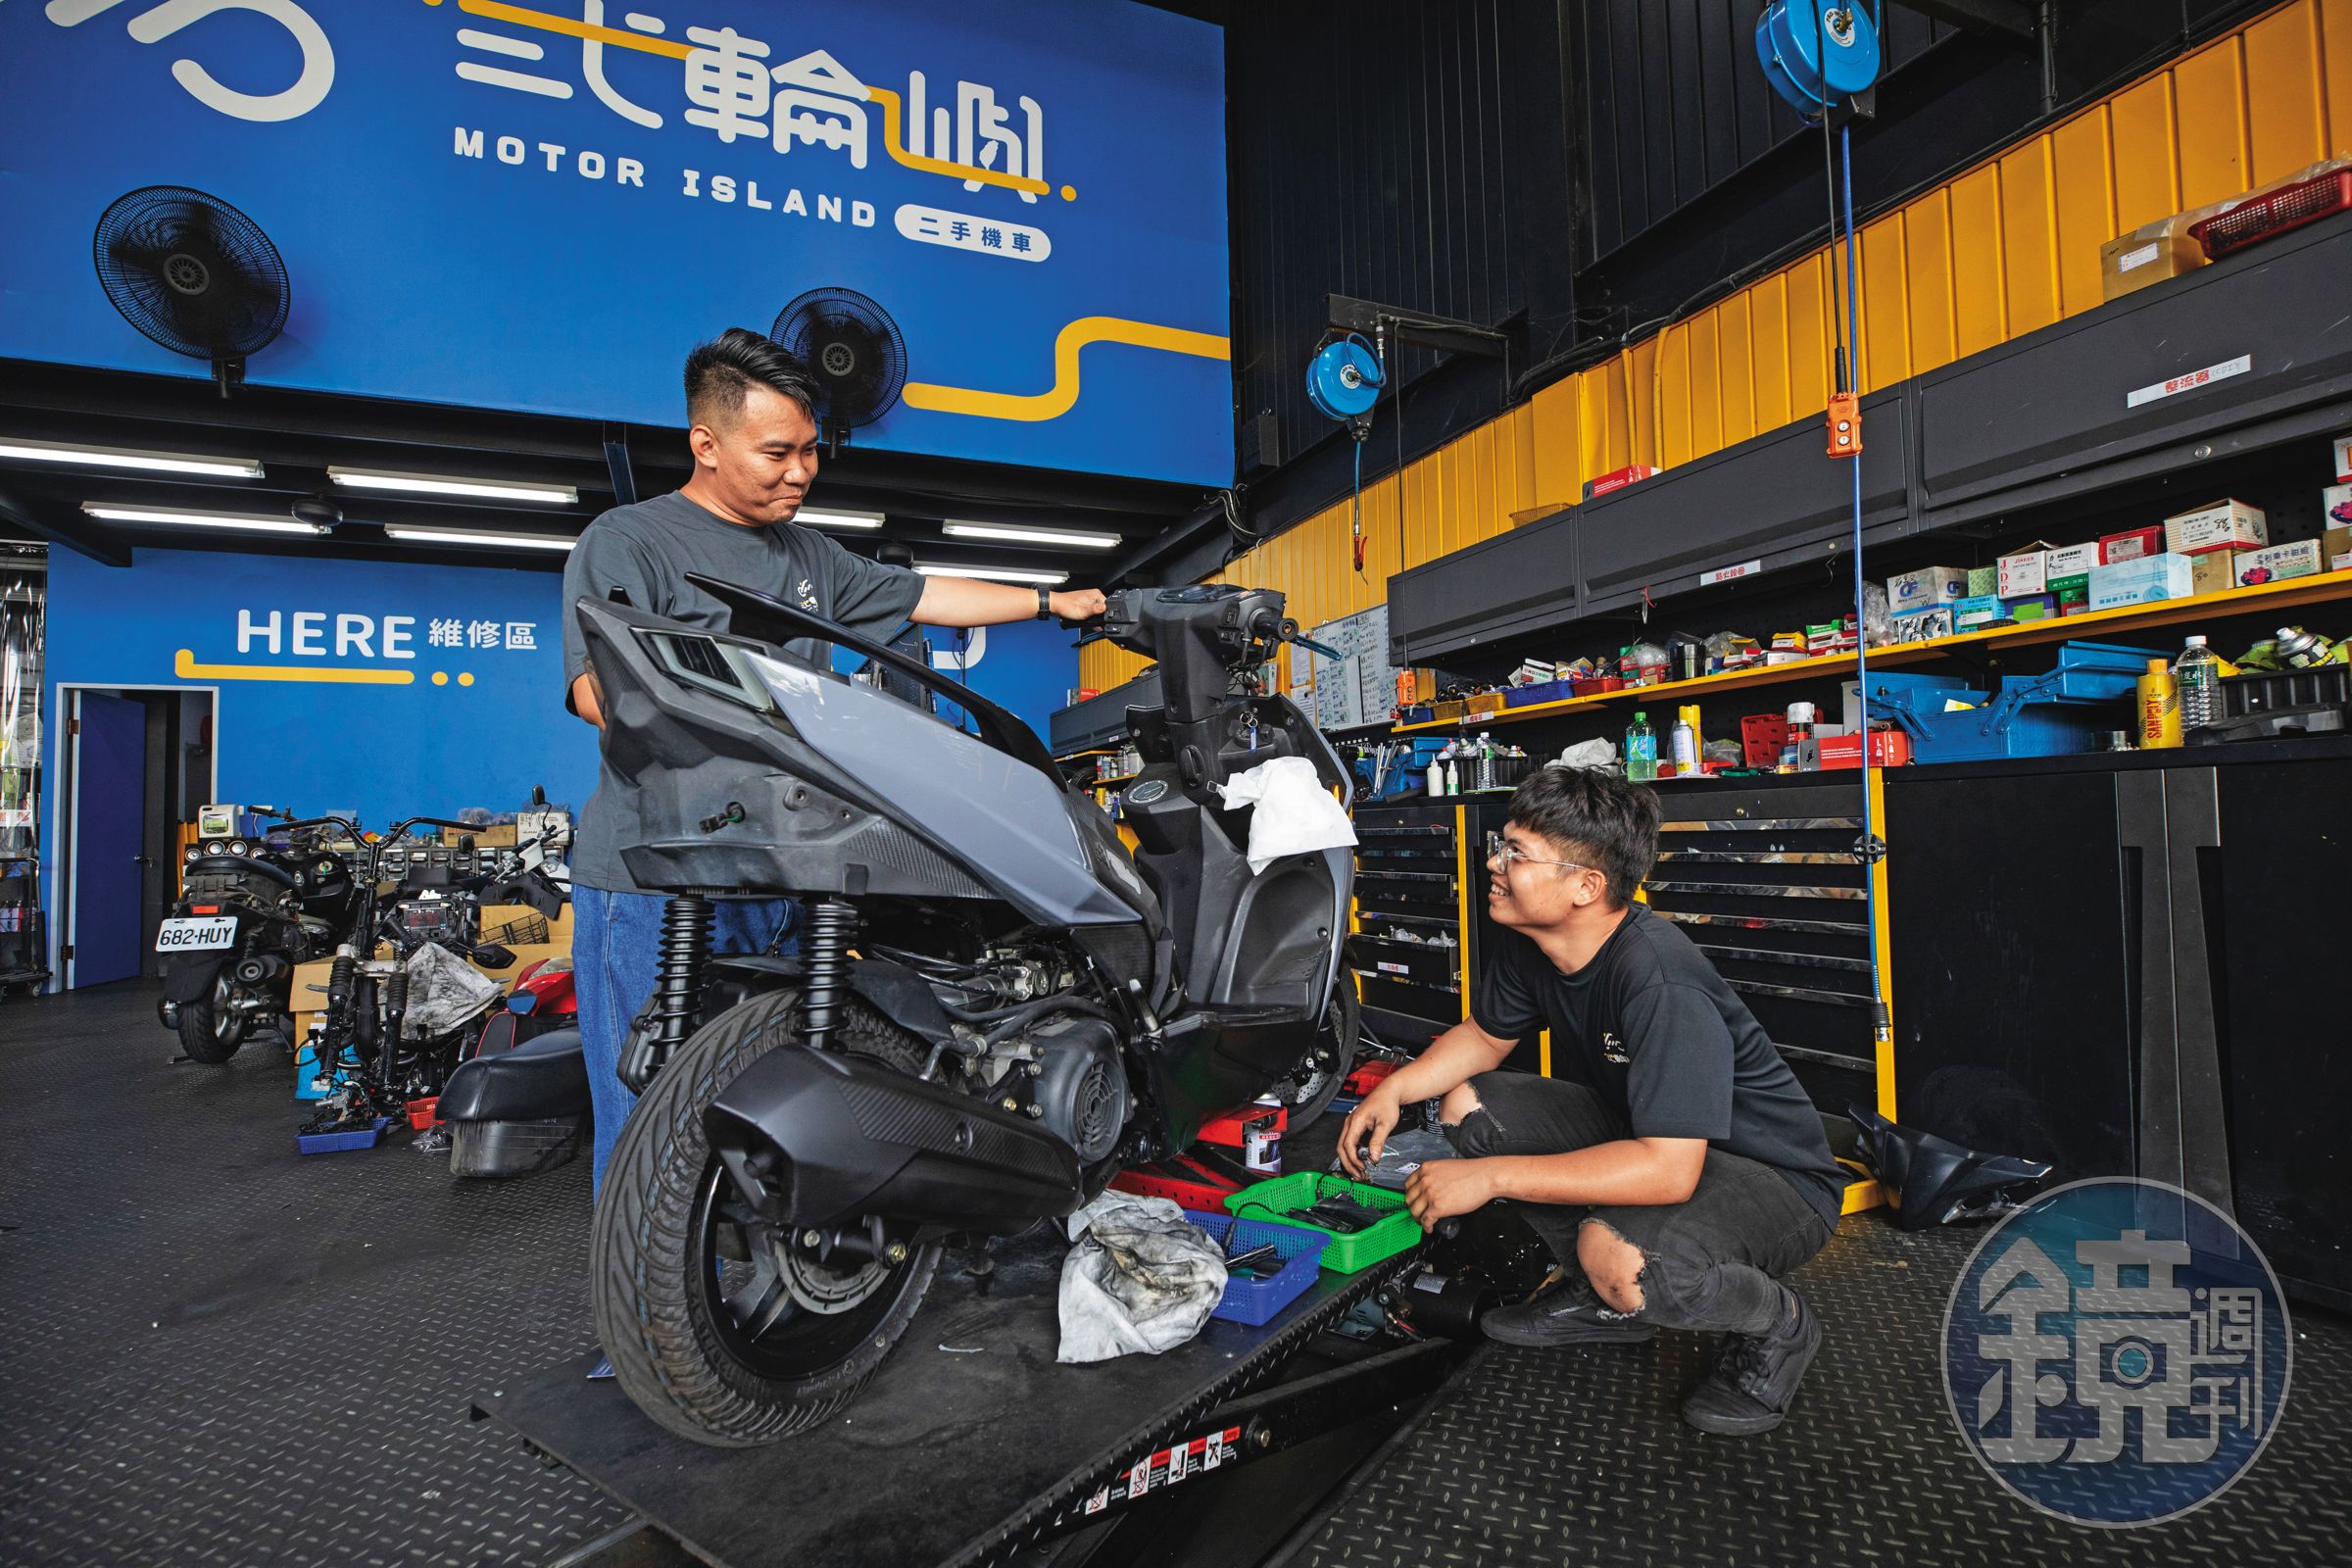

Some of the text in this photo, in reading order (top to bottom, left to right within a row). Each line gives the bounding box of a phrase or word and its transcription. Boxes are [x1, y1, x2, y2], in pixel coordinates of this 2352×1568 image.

[455, 126, 875, 227] MOTOR ISLAND
[918, 216, 1032, 253] 二手機車
[238, 609, 538, 659] HERE 維修區
[160, 926, 232, 946] 682-HUY
